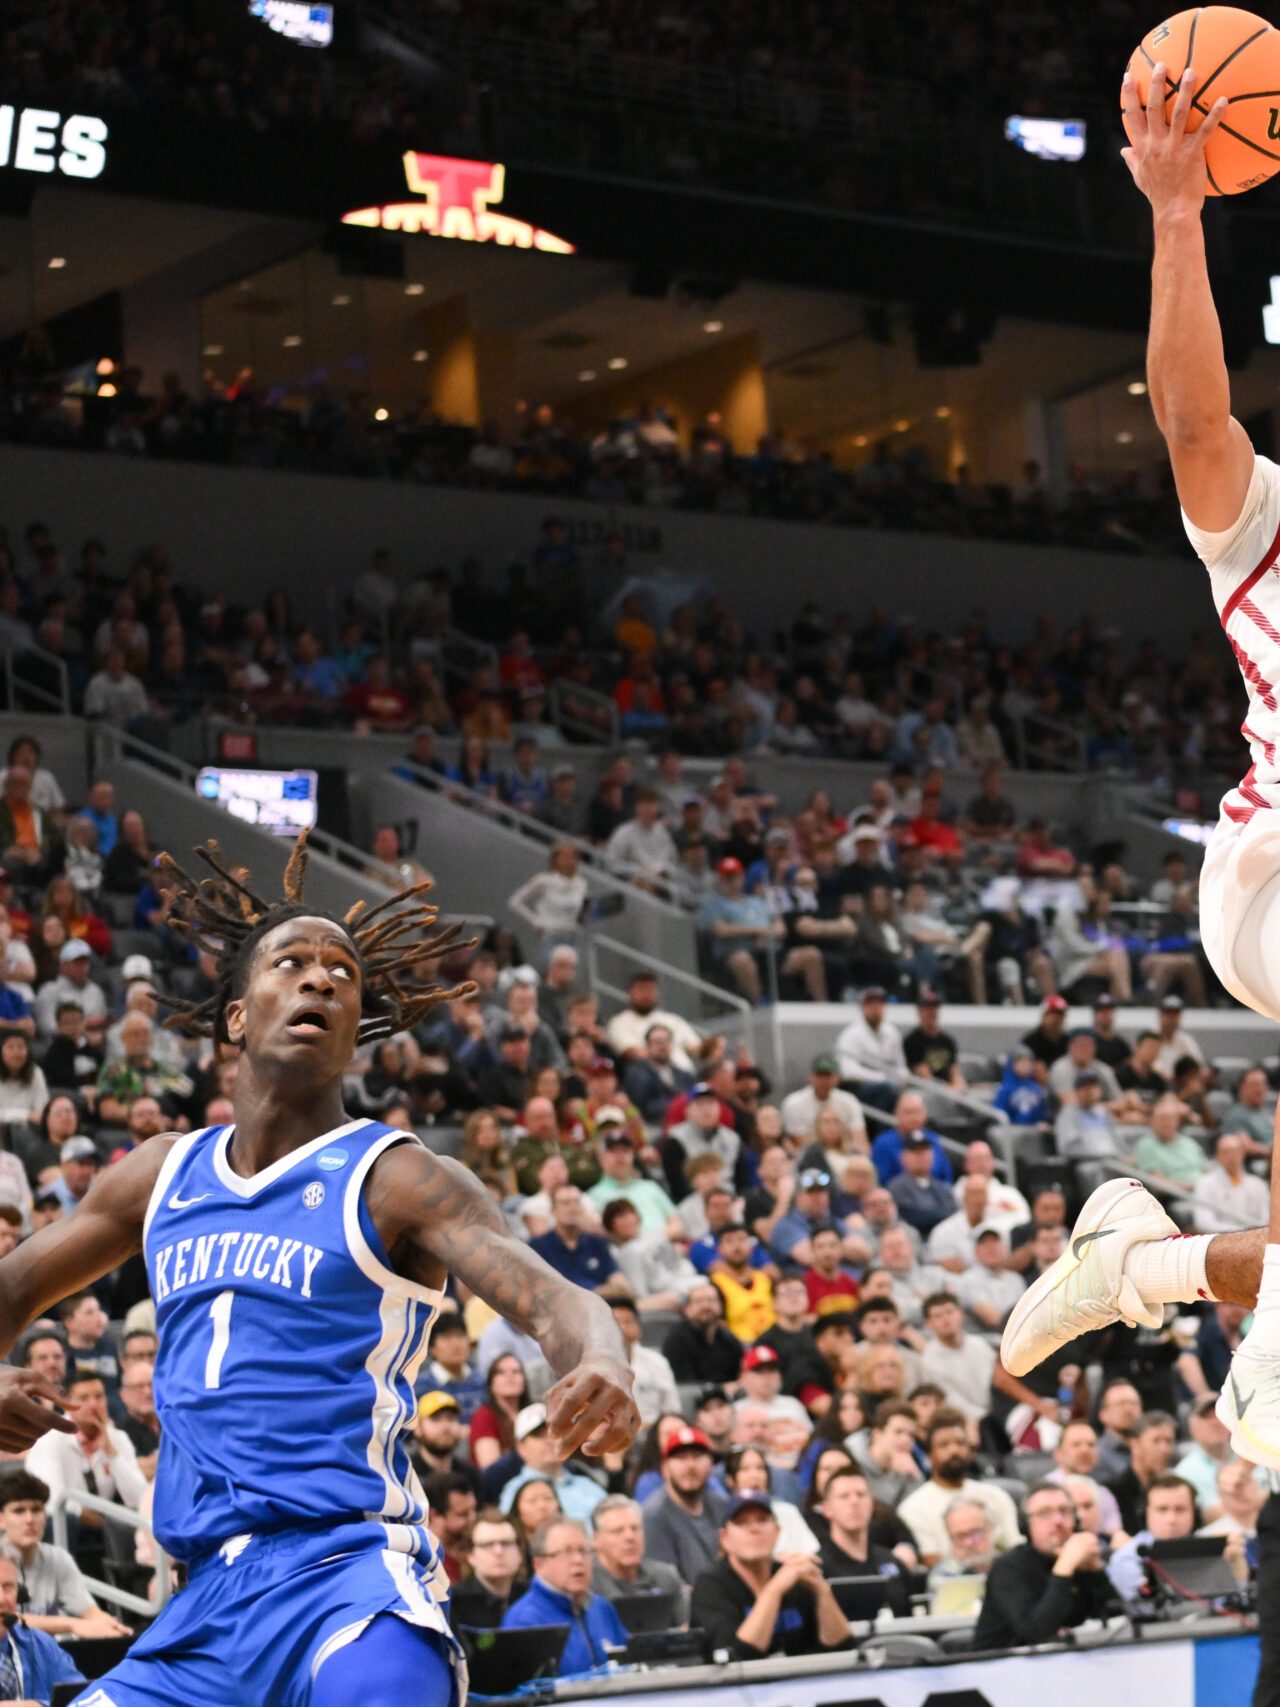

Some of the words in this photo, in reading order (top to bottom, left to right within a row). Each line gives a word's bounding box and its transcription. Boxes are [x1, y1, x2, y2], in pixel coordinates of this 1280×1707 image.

[304, 1183, 324, 1208] SEC
[155, 1232, 324, 1303] KENTUCKY
[205, 1289, 235, 1390] 1
